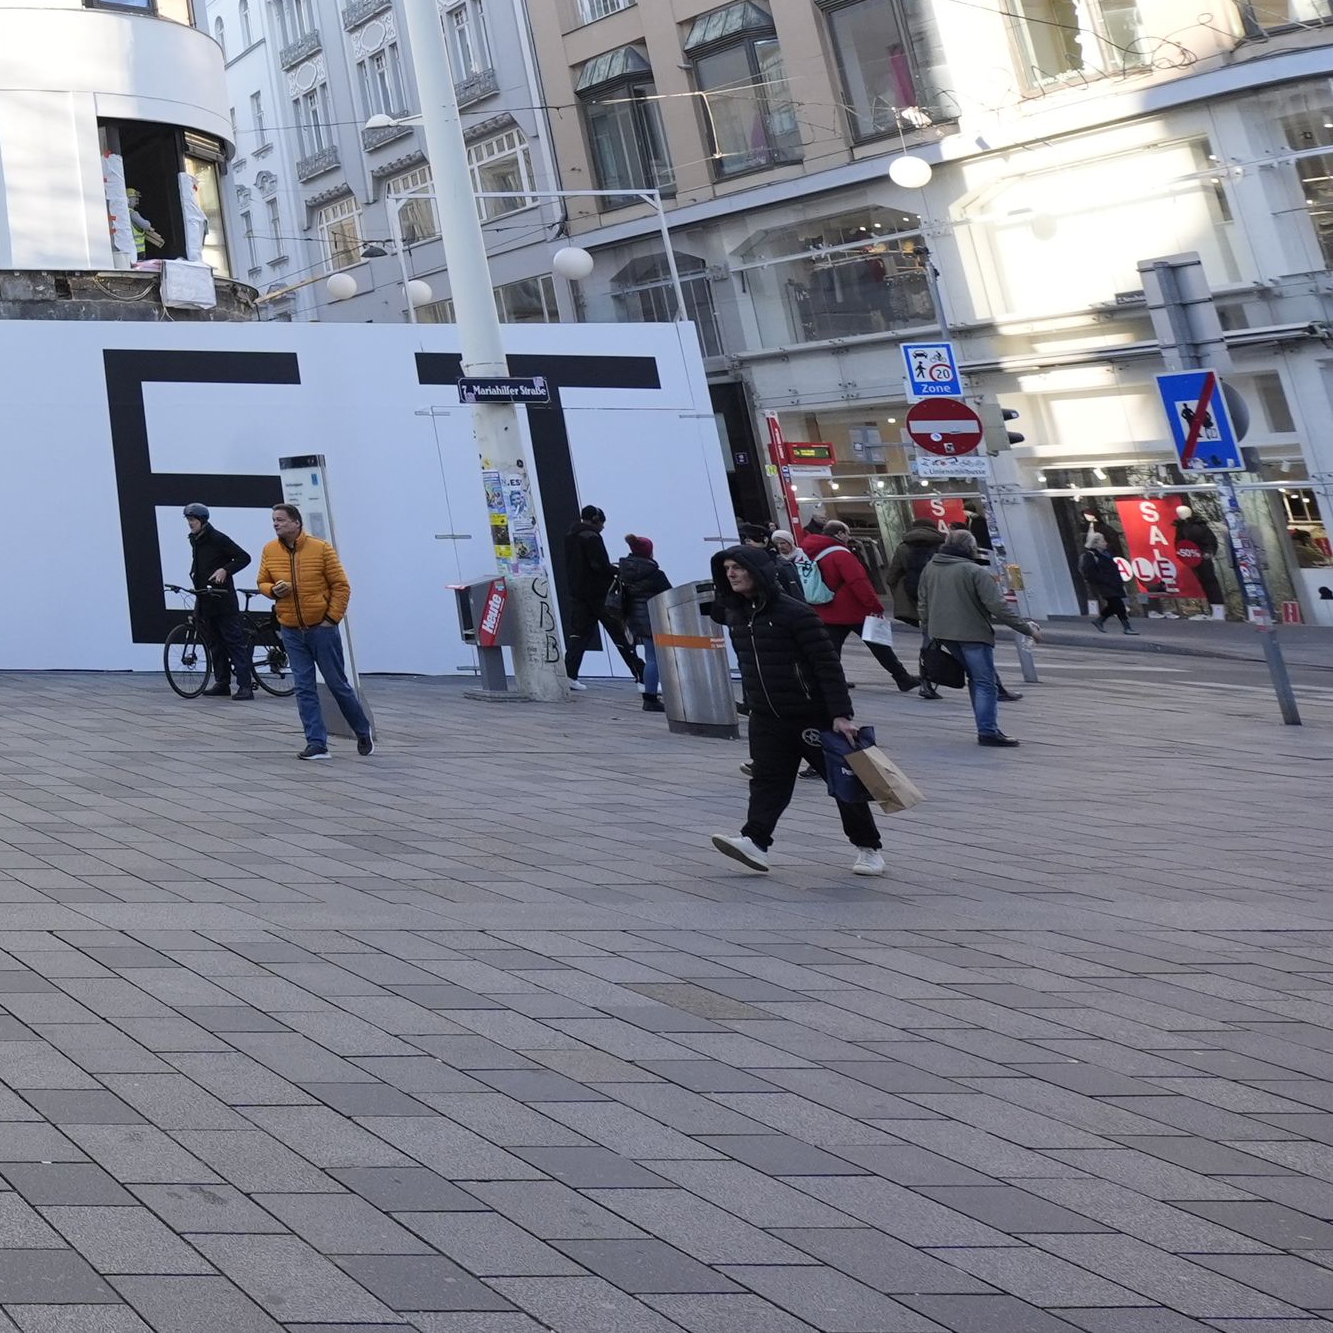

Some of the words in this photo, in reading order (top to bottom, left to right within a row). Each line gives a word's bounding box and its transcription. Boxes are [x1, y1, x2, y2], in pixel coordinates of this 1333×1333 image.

[936, 368, 950, 379] 20
[473, 385, 519, 396] Mariahilfer
[519, 385, 547, 396] Straße
[921, 383, 952, 393] Zone
[481, 593, 503, 635] Heute
